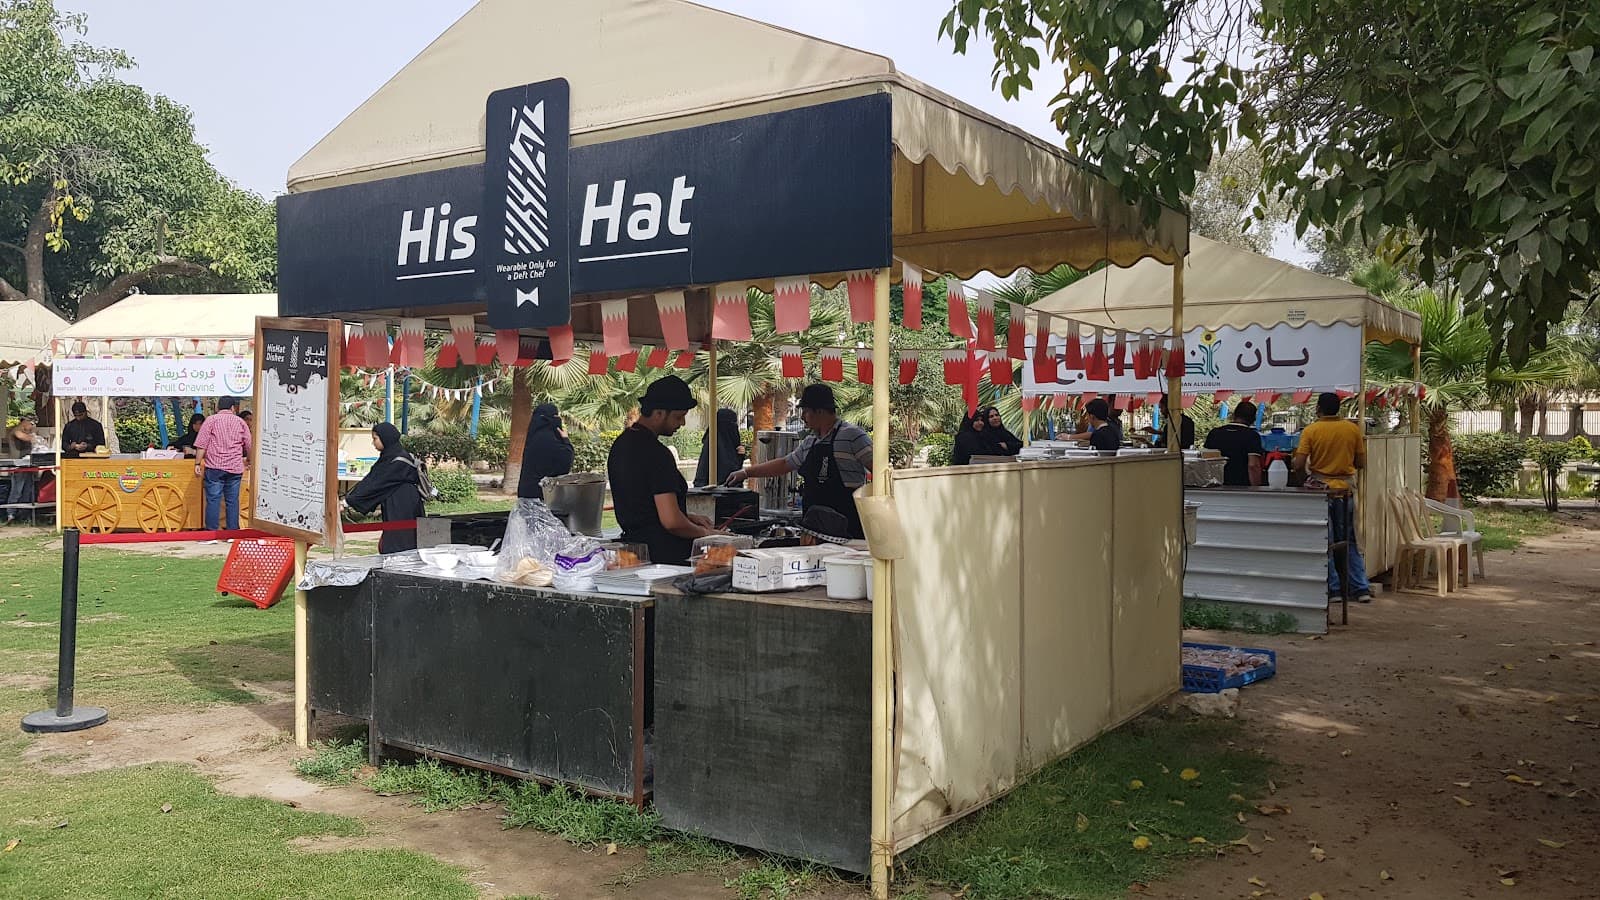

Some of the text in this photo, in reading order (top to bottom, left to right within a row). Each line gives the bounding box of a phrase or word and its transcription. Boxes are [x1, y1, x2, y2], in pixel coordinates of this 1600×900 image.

[398, 202, 478, 265] His
[579, 175, 696, 247] Hat
[496, 259, 557, 273] Wearable Only for
[513, 271, 528, 280] Deft
[530, 269, 546, 278] Chef
[266, 352, 285, 362] Dishes
[1236, 336, 1310, 378] بان
[154, 382, 215, 392] Fruit Craving
